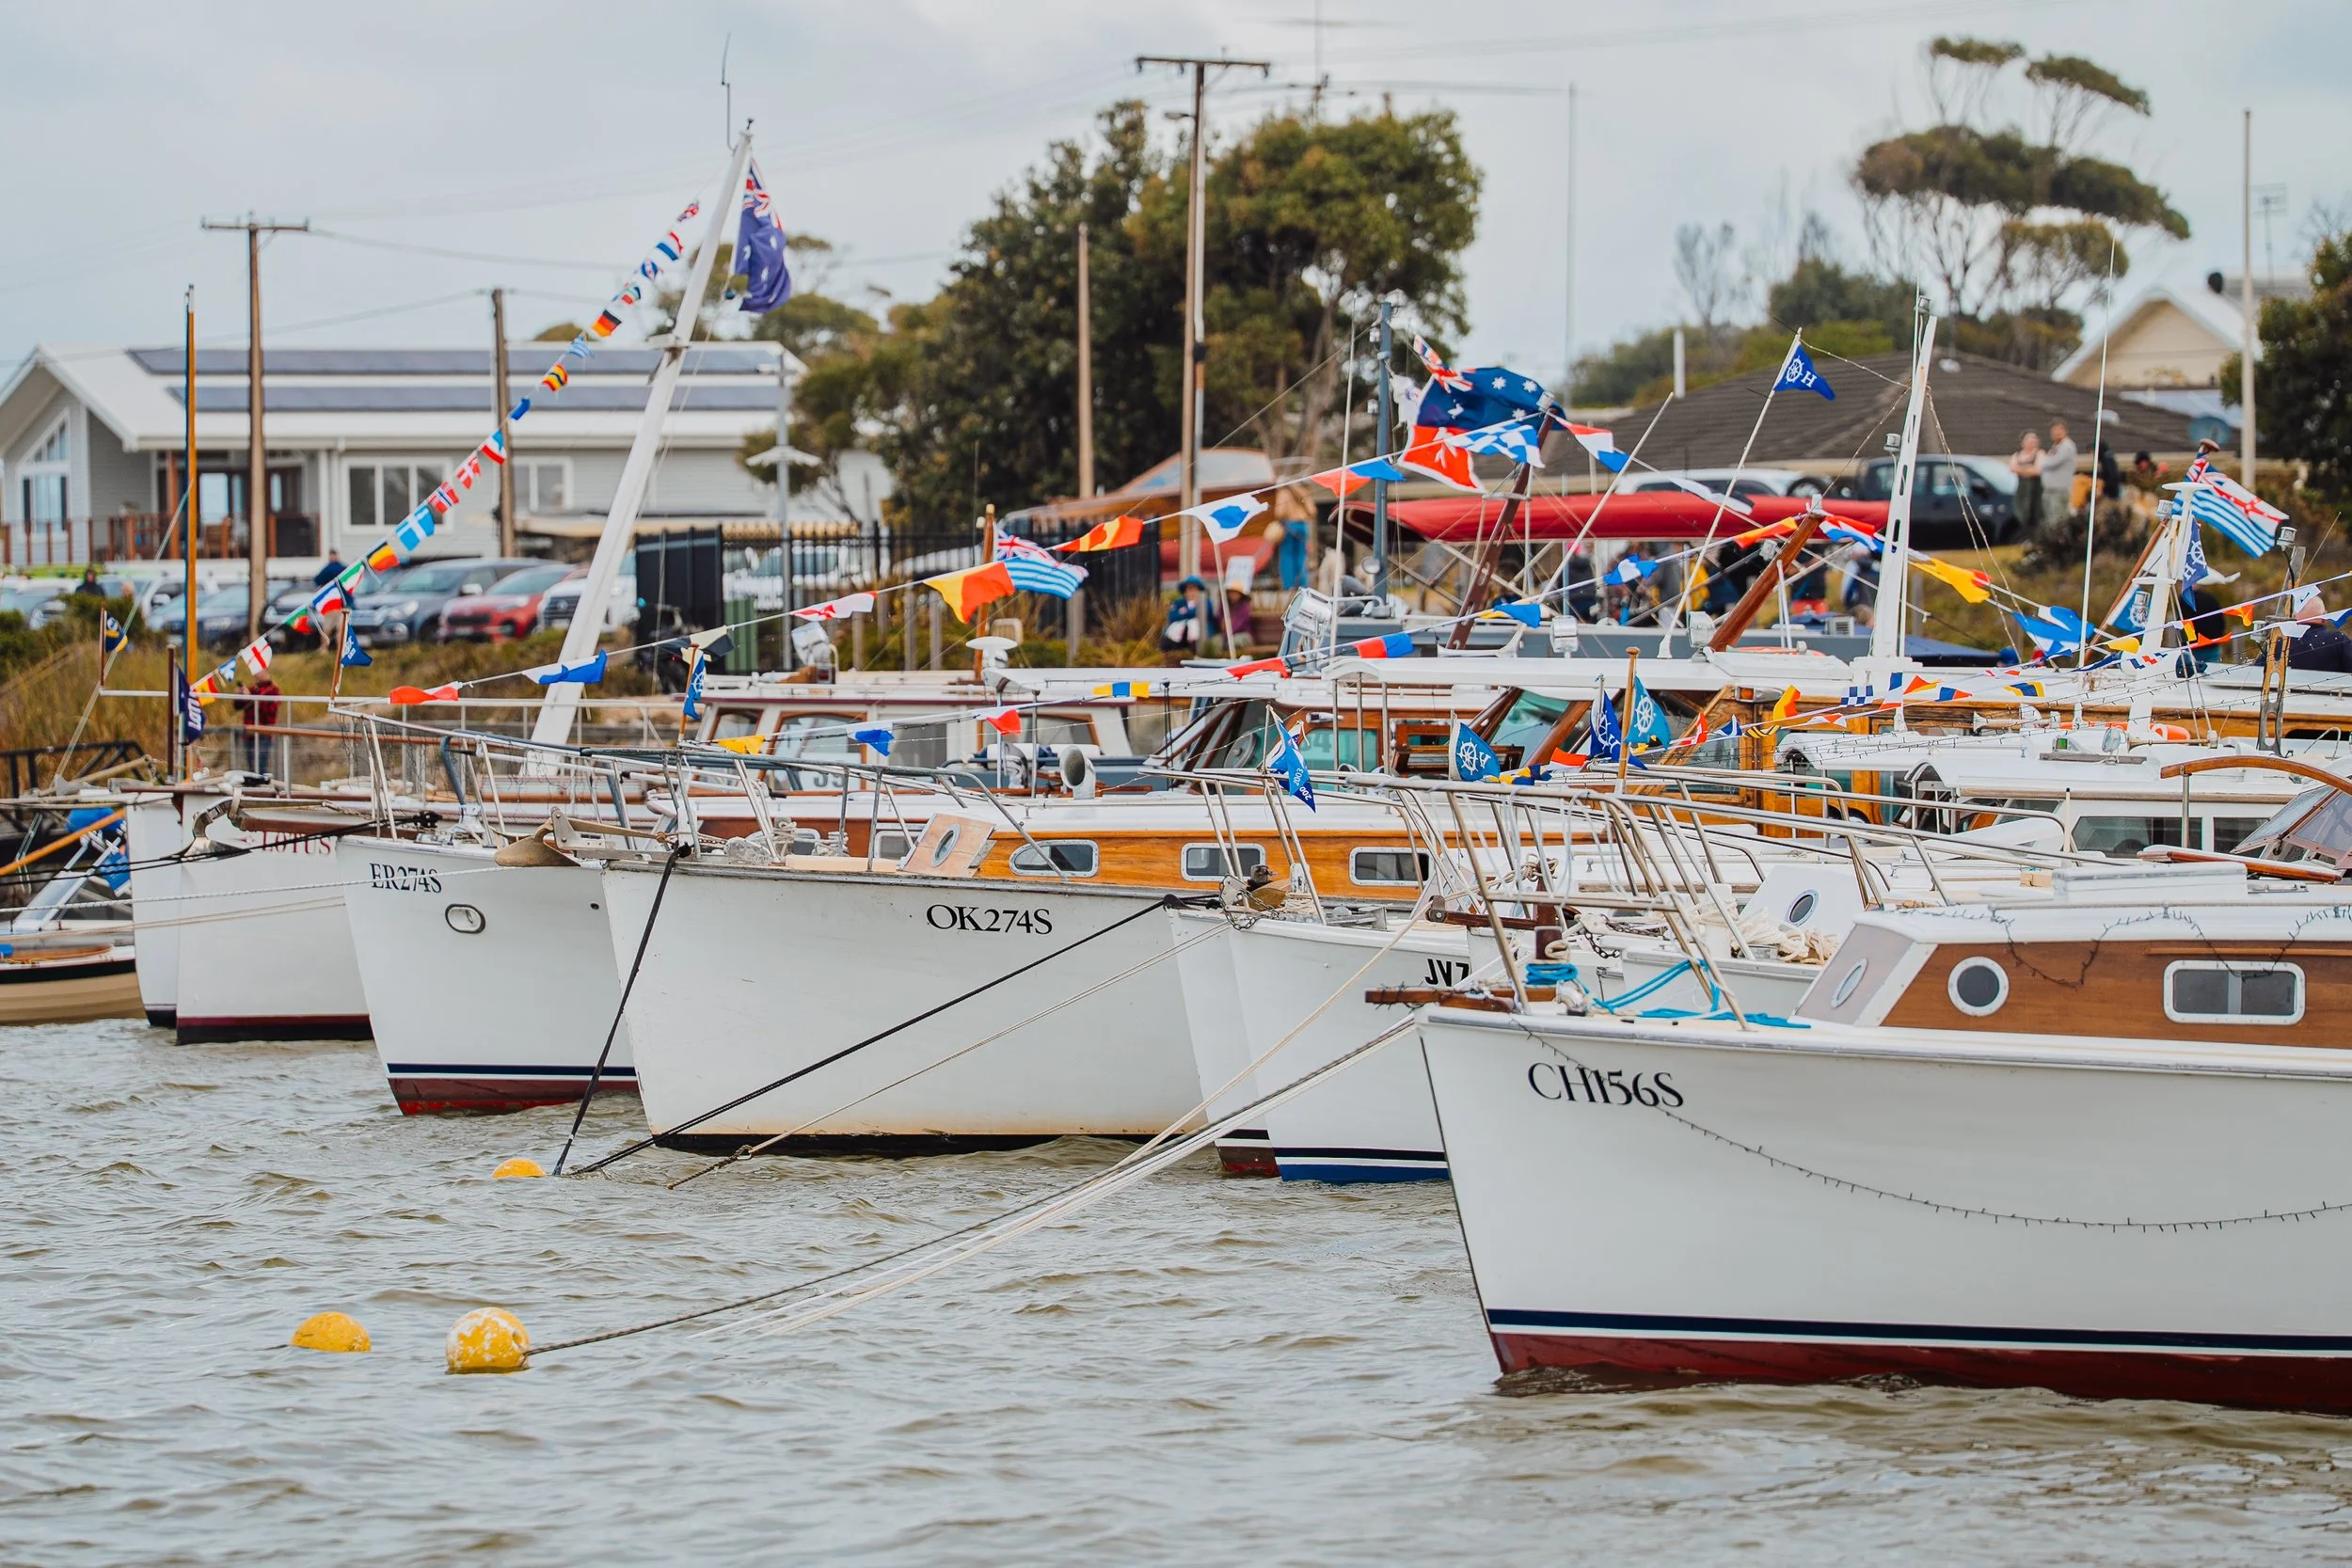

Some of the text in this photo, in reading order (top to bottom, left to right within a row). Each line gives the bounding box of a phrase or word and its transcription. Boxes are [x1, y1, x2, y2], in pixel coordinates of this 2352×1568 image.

[1801, 371, 1817, 388] H
[1294, 768, 1304, 786] 2003
[1299, 786, 1311, 800] 200
[262, 832, 331, 854] LOTUS
[370, 863, 441, 893] ER274S
[927, 904, 1053, 934] OK274S
[1424, 958, 1470, 987] JV7
[1528, 1062, 1684, 1107] CH156S
